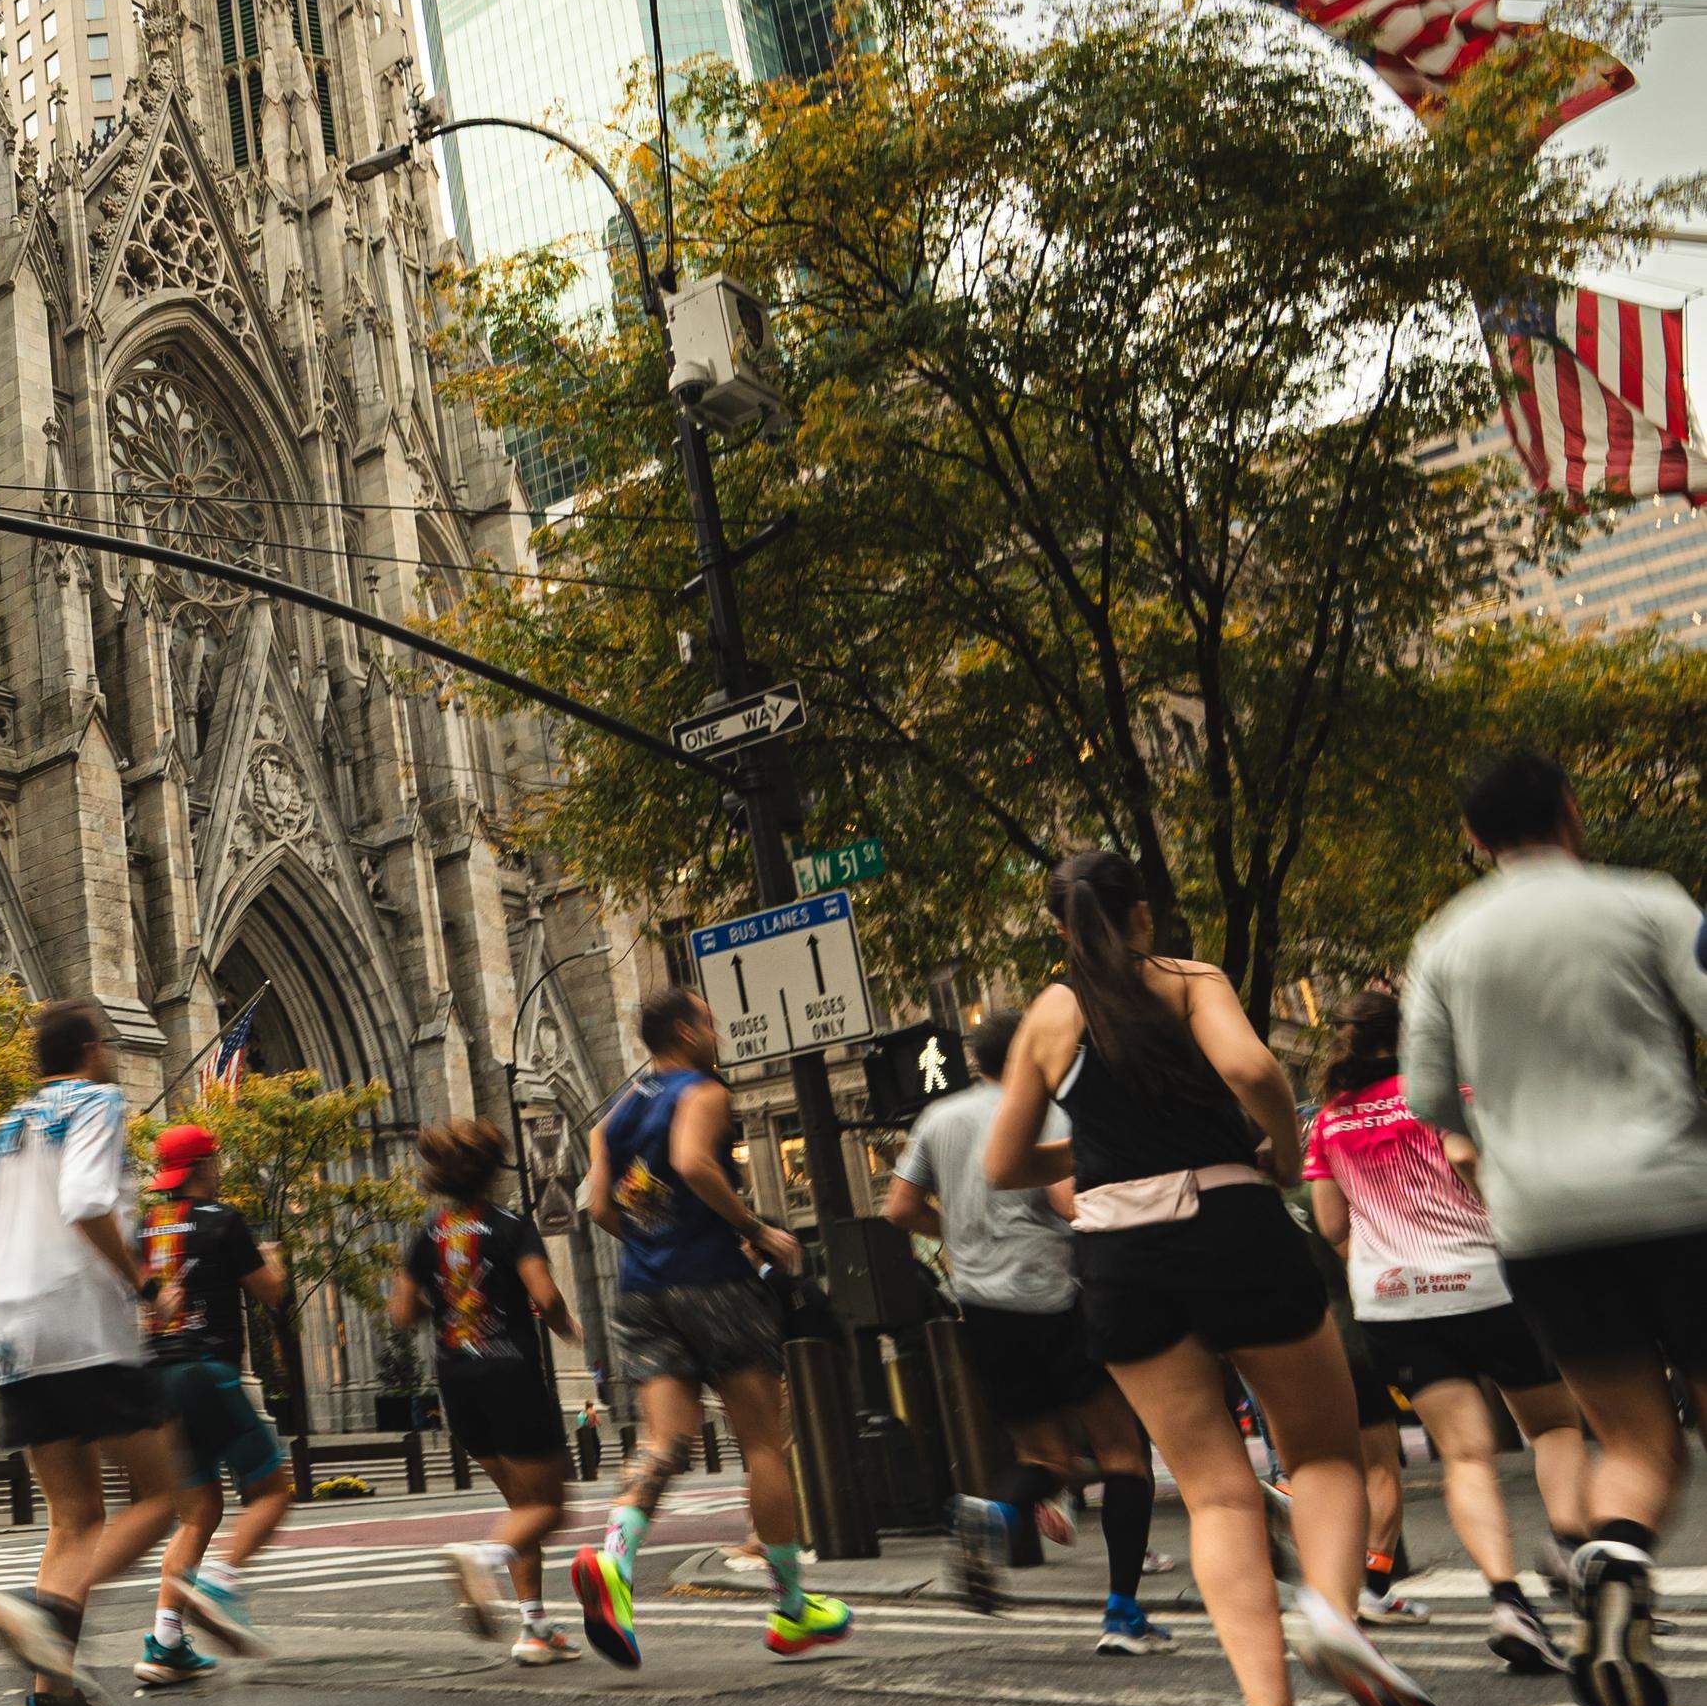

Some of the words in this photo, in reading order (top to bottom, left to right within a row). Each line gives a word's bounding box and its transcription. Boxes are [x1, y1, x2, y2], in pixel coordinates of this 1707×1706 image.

[685, 724, 723, 749] ONE
[742, 700, 782, 730] WAY
[815, 856, 832, 886] W
[838, 848, 859, 881] 51
[728, 920, 759, 944] BUS
[762, 906, 811, 935] LANES
[805, 994, 846, 1021] BUSES
[729, 1013, 768, 1039] BUSES
[812, 1016, 845, 1041] ONLY
[736, 1035, 767, 1059] ONLY
[1357, 1095, 1409, 1115] TOGET
[1413, 1275, 1426, 1285] TU
[1429, 1271, 1472, 1284] SEGURO
[1415, 1285, 1429, 1295] DE
[1431, 1283, 1466, 1294] SALUD
